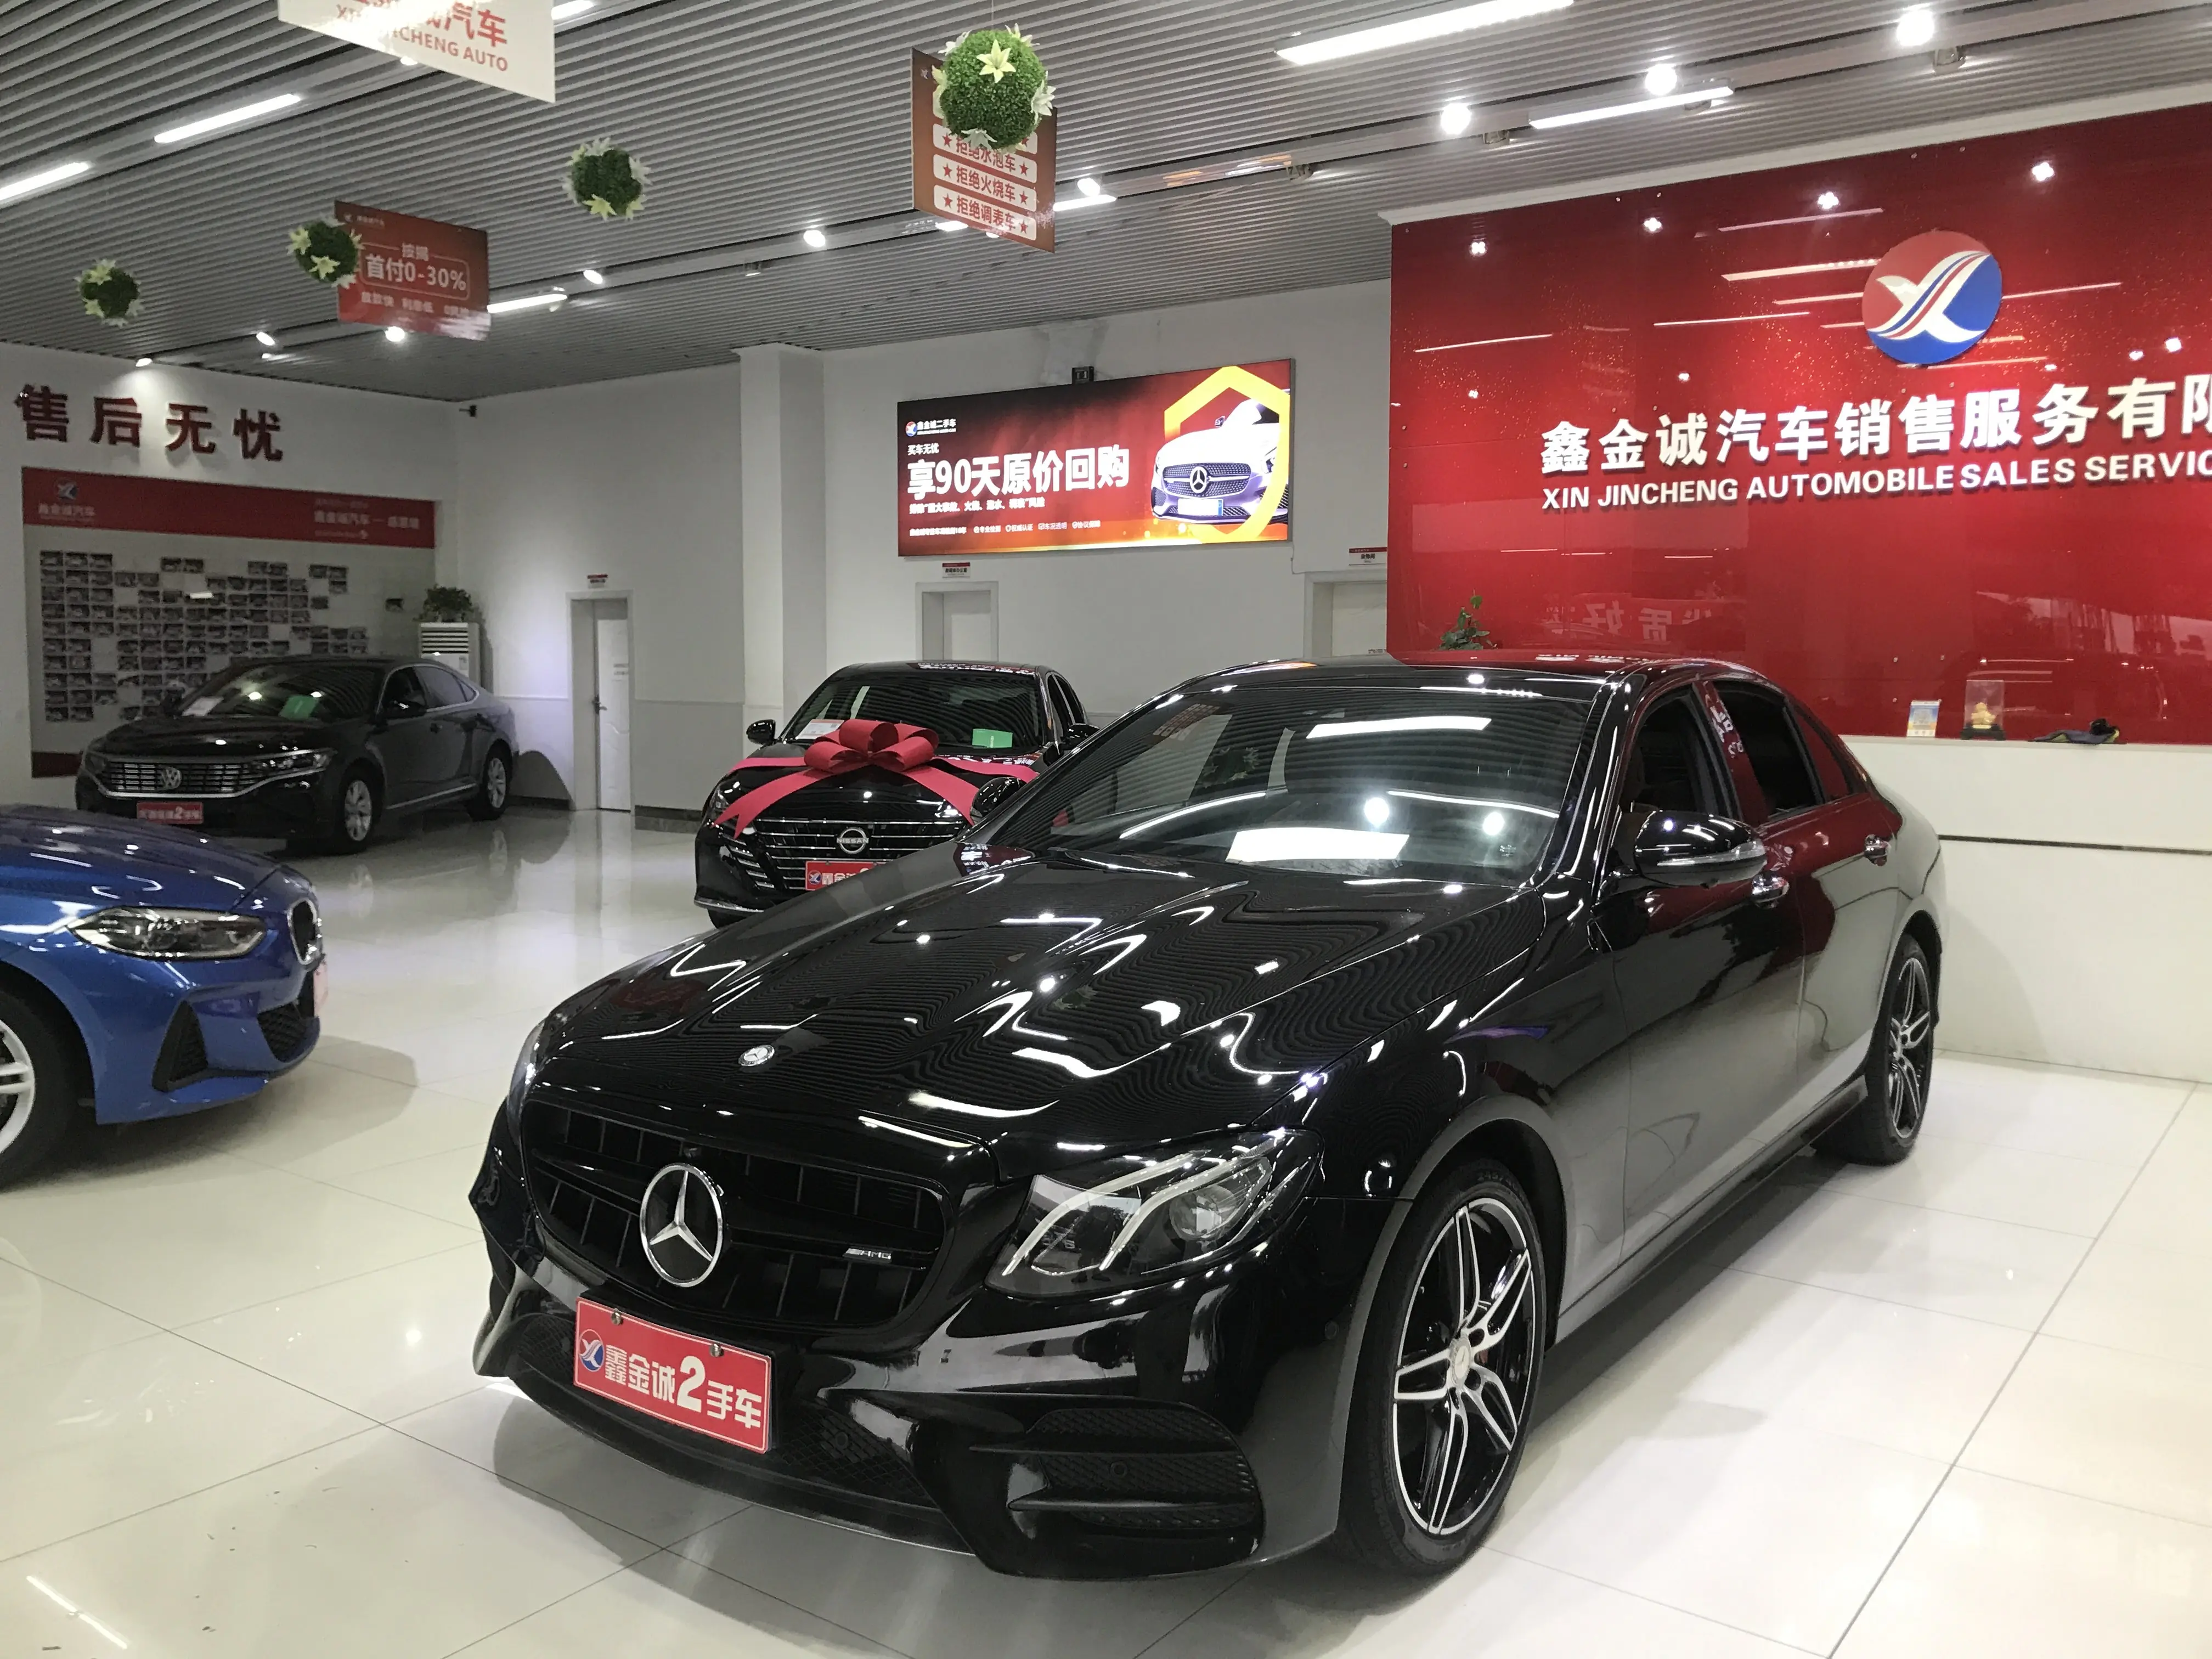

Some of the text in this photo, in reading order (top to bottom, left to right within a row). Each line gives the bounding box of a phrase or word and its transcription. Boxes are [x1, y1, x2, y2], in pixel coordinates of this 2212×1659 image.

[462, 46, 508, 72] AUTO
[956, 165, 1016, 202] 拒绝火烧车
[956, 195, 1017, 231] 拒绝调表车
[14, 384, 283, 462] 售后无忧
[907, 442, 940, 456] 买车无忧
[907, 444, 1130, 500] 享90天原价回购
[1542, 449, 2212, 510] XIN JINCHENG AUTOMOBILE SALES SERVIC
[860, 1250, 891, 1260] AMG
[605, 1344, 763, 1429] 鑫金诚2手车
